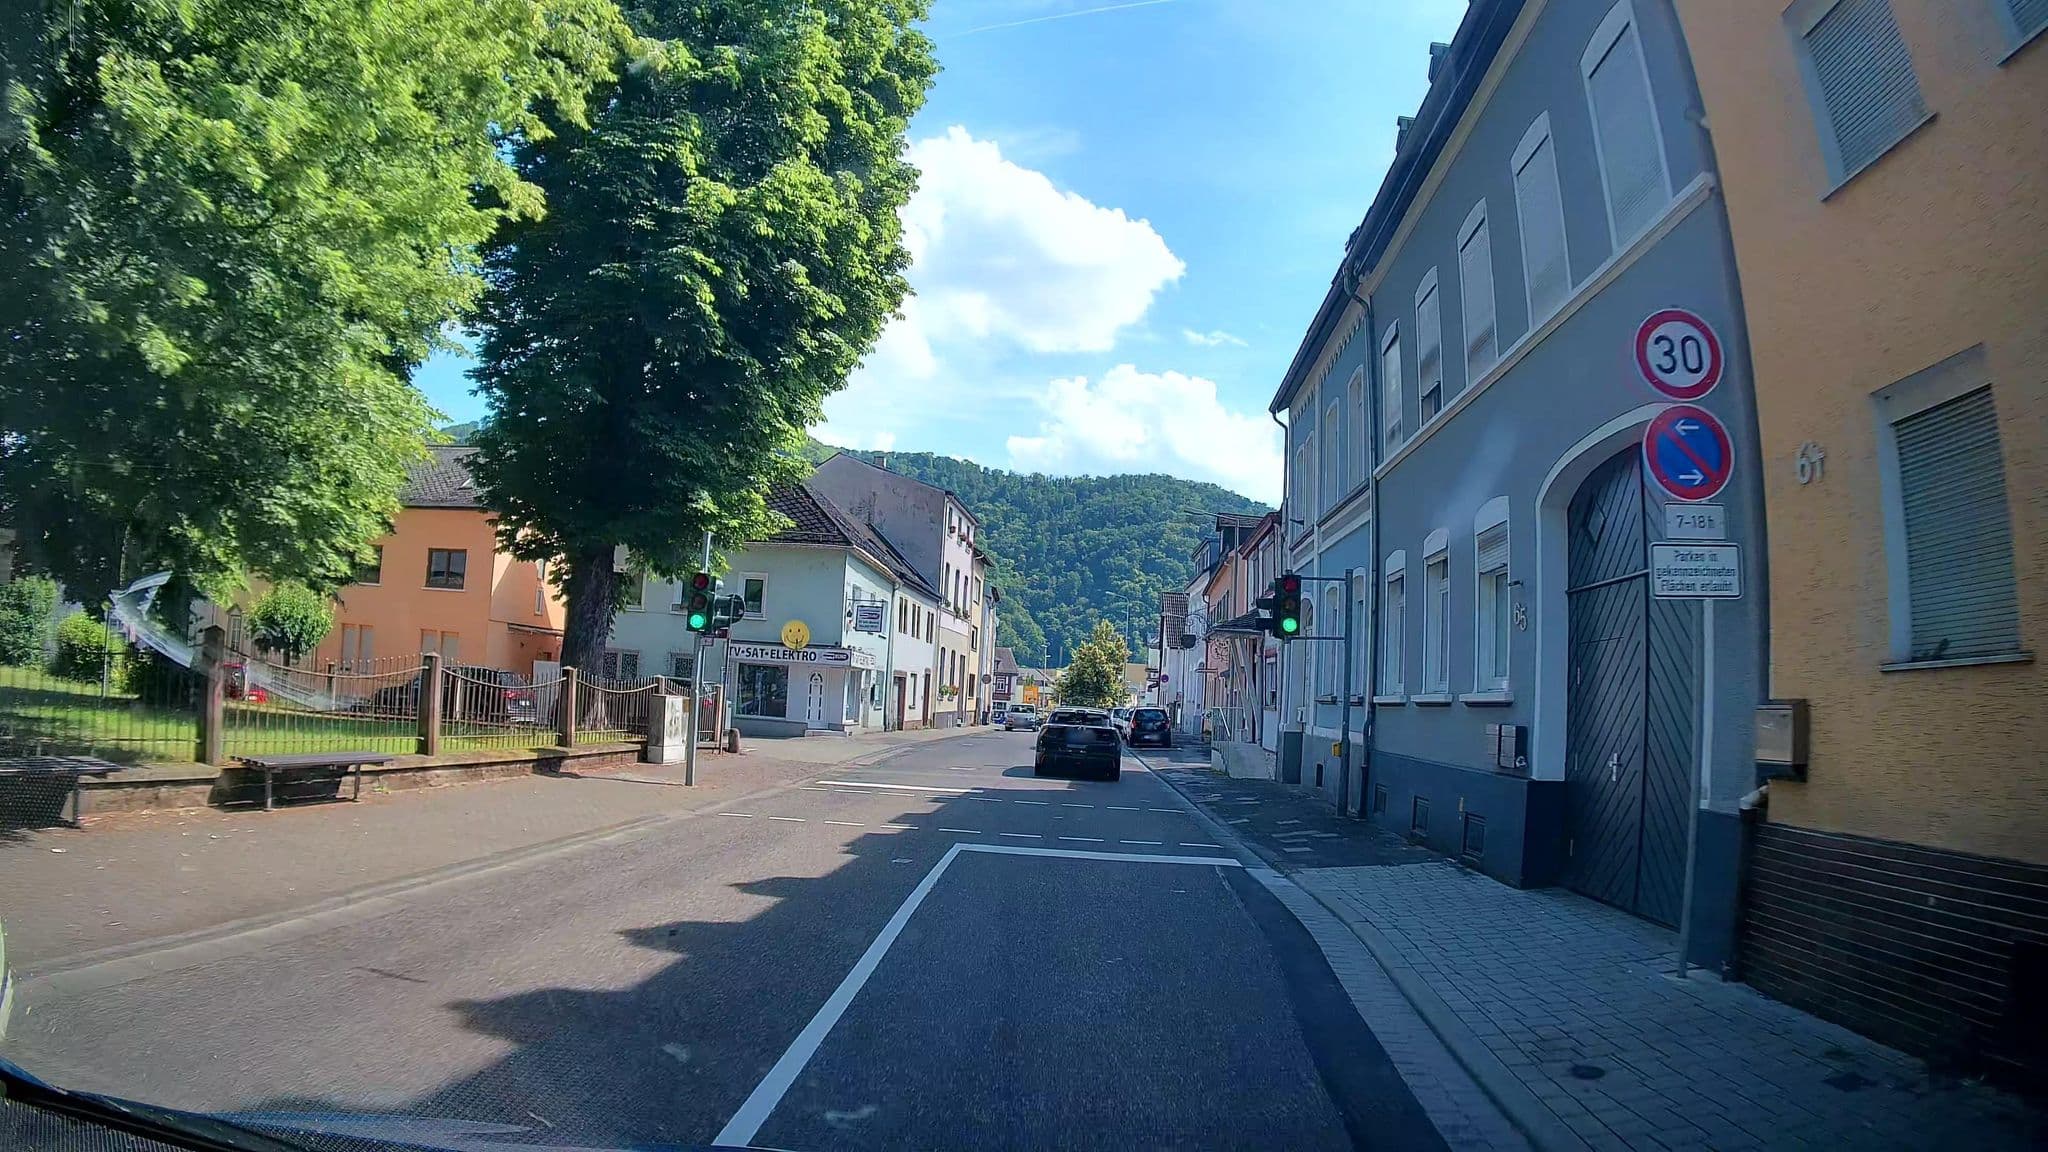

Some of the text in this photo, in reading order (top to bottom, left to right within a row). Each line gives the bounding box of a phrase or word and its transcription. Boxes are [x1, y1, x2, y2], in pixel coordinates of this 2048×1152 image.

[1653, 334, 1703, 374] 30
[1673, 550, 1718, 562] Parken in
[1700, 580, 1733, 593] erlaubt
[1513, 602, 1527, 631] 65
